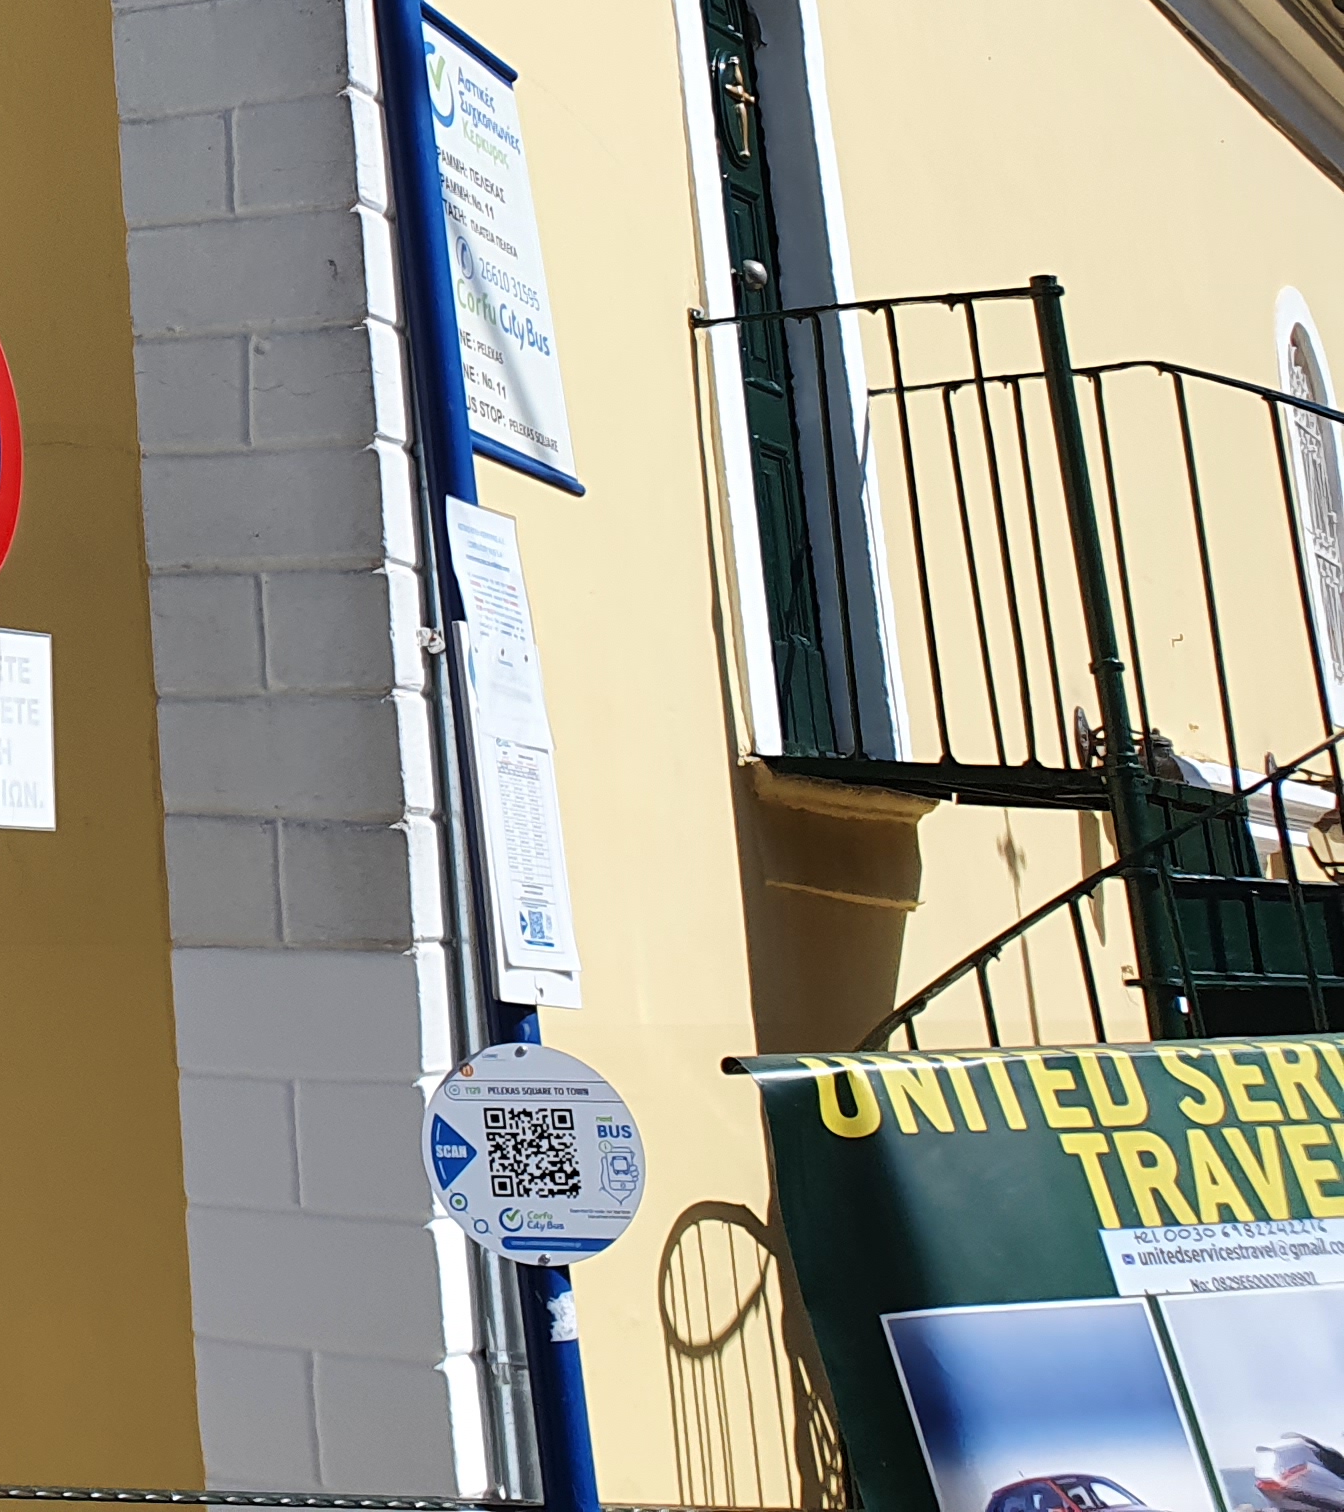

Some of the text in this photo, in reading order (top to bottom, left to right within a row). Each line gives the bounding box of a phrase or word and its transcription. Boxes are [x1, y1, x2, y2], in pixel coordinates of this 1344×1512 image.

[485, 202, 495, 220] 11
[479, 257, 510, 294] 26610
[457, 278, 496, 326] Corfu
[525, 317, 550, 356] Bus
[497, 382, 506, 399] 11
[554, 1087, 564, 1095] TO
[797, 1047, 1149, 1138] UNITED
[597, 1124, 633, 1139] BUS
[435, 1144, 467, 1158] SCAN
[527, 1210, 553, 1220] Corfu
[1133, 1230, 1160, 1245] tel
[1163, 1226, 1216, 1243] 0030
